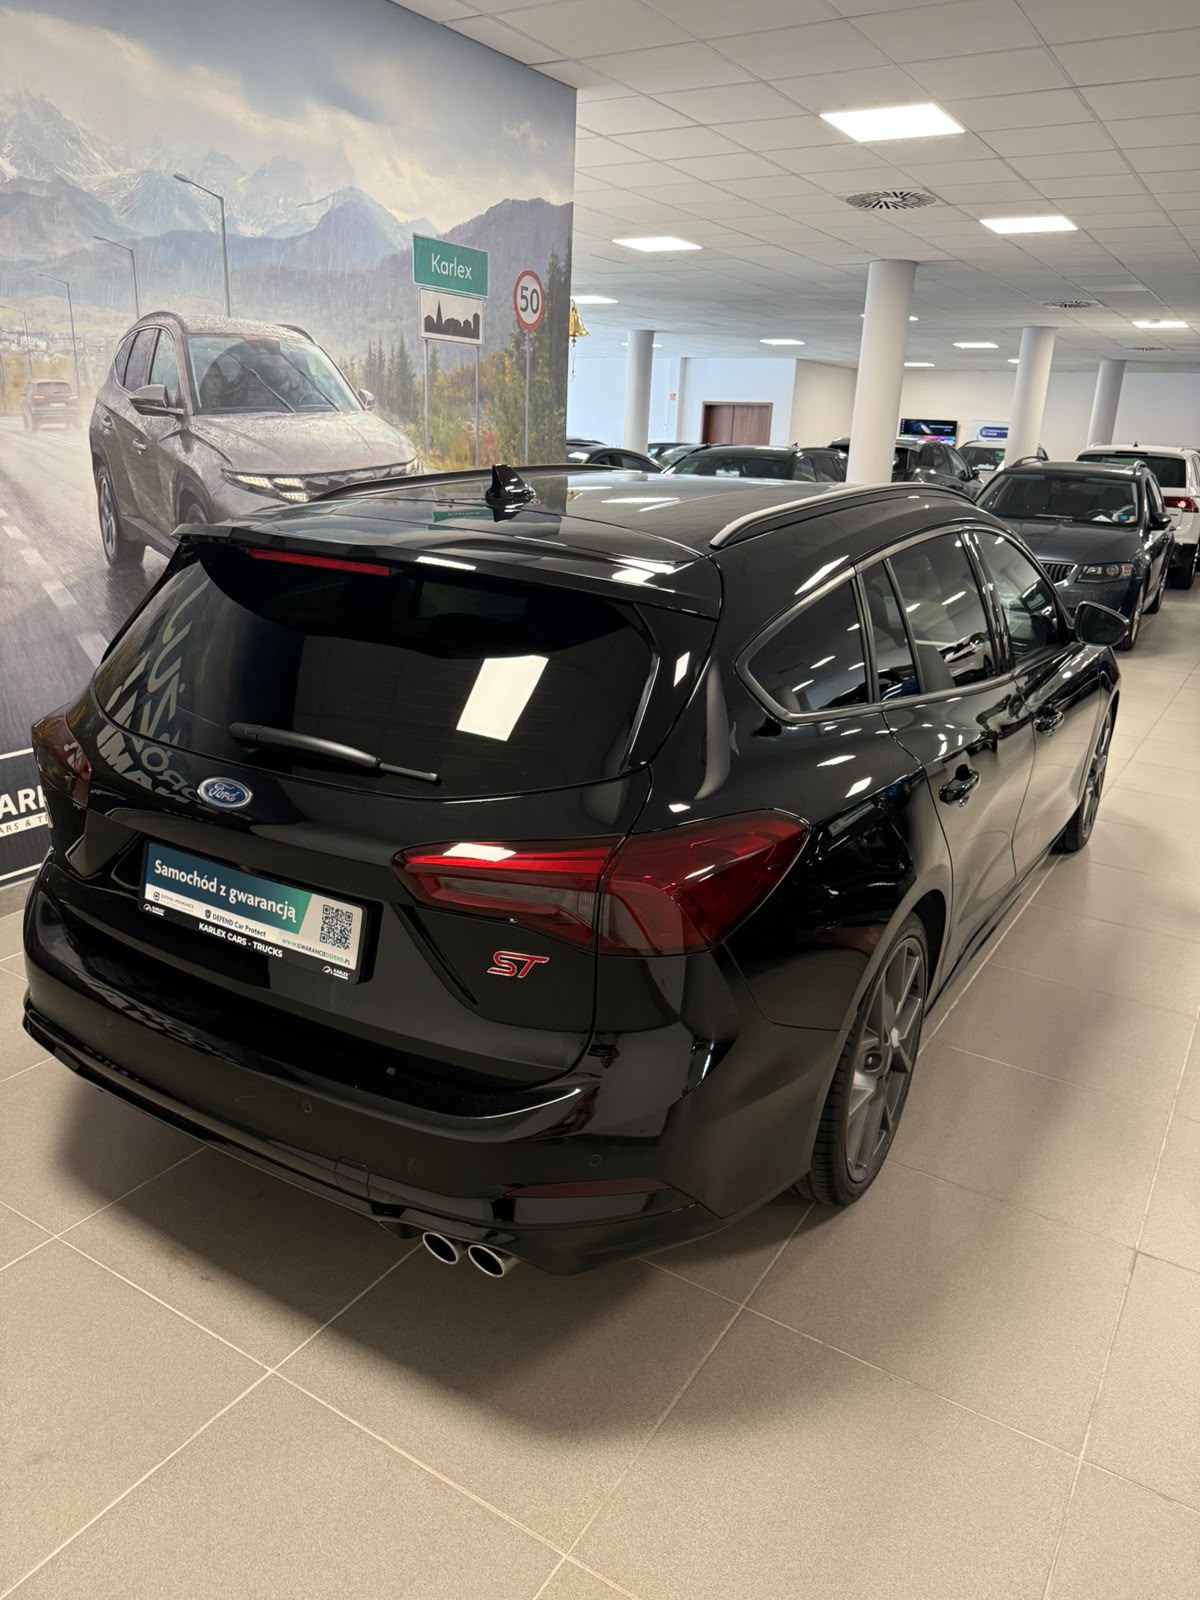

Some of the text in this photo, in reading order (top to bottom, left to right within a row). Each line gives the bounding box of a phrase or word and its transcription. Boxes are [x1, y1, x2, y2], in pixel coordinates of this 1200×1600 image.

[431, 252, 473, 280] Karlex
[519, 285, 540, 315] 50
[209, 782, 241, 802] Ford
[154, 860, 297, 924] Samochód z gwarancją
[198, 922, 227, 940] KARLEX
[226, 933, 248, 946] CARS
[253, 942, 283, 958] TRUCKS
[212, 913, 267, 938] DEFEND Car Protect
[486, 950, 551, 979] ST
